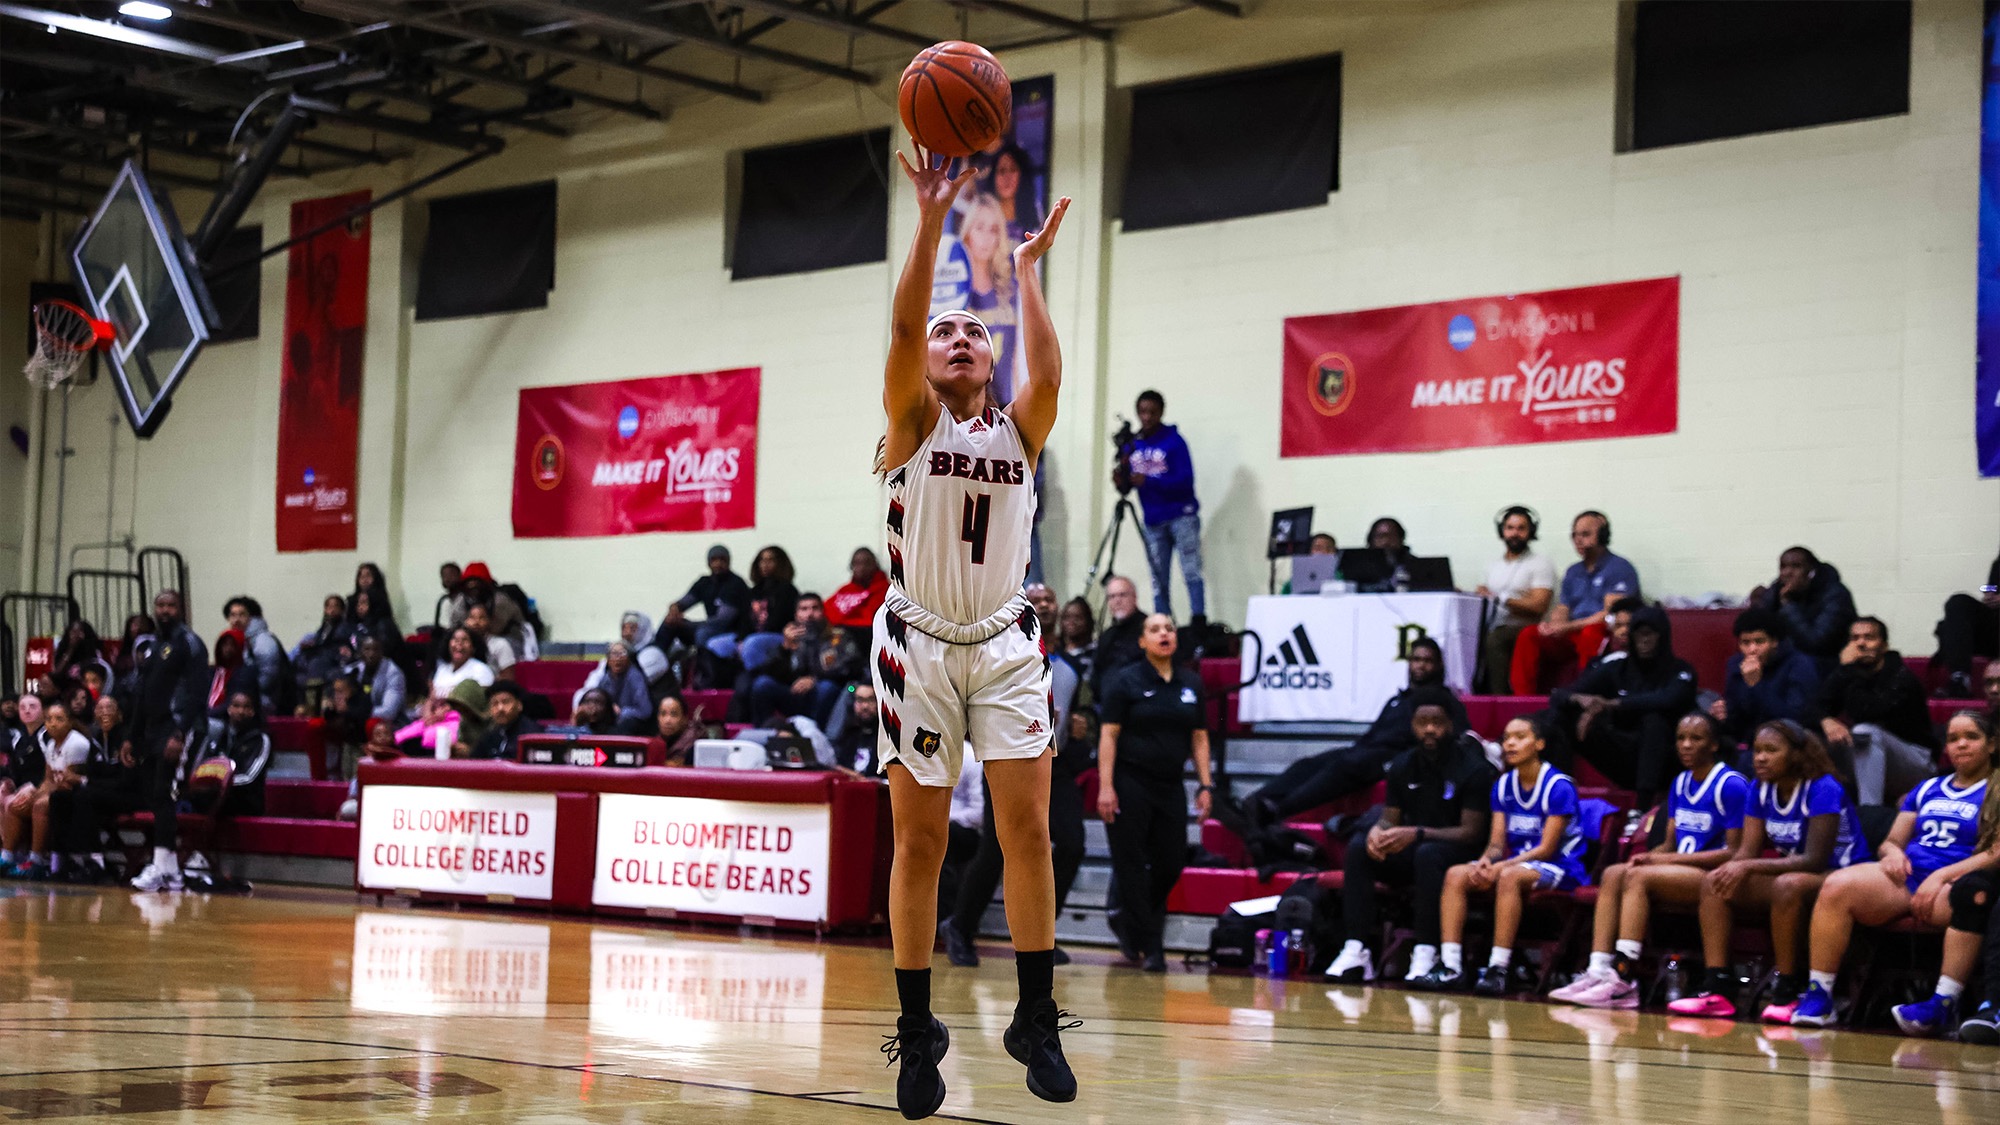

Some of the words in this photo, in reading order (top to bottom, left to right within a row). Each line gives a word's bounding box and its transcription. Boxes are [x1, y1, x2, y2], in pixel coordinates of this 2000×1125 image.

[1411, 378, 1485, 409] MAKE
[1490, 375, 1517, 402] IT
[1517, 349, 1627, 416] YOURS
[592, 462, 642, 486] MAKE
[645, 459, 665, 483] IT
[665, 438, 740, 495] YOURS
[928, 451, 1024, 485] BEARS
[961, 490, 992, 565] 4
[393, 808, 529, 837] BLOOMFIELD
[634, 820, 793, 853] BLOOMFIELD
[1919, 819, 1960, 848] 25
[374, 843, 465, 871] COLLEGE
[472, 847, 546, 875] BEARS
[611, 858, 719, 888] COLLEGE
[726, 865, 812, 895] BEARS
